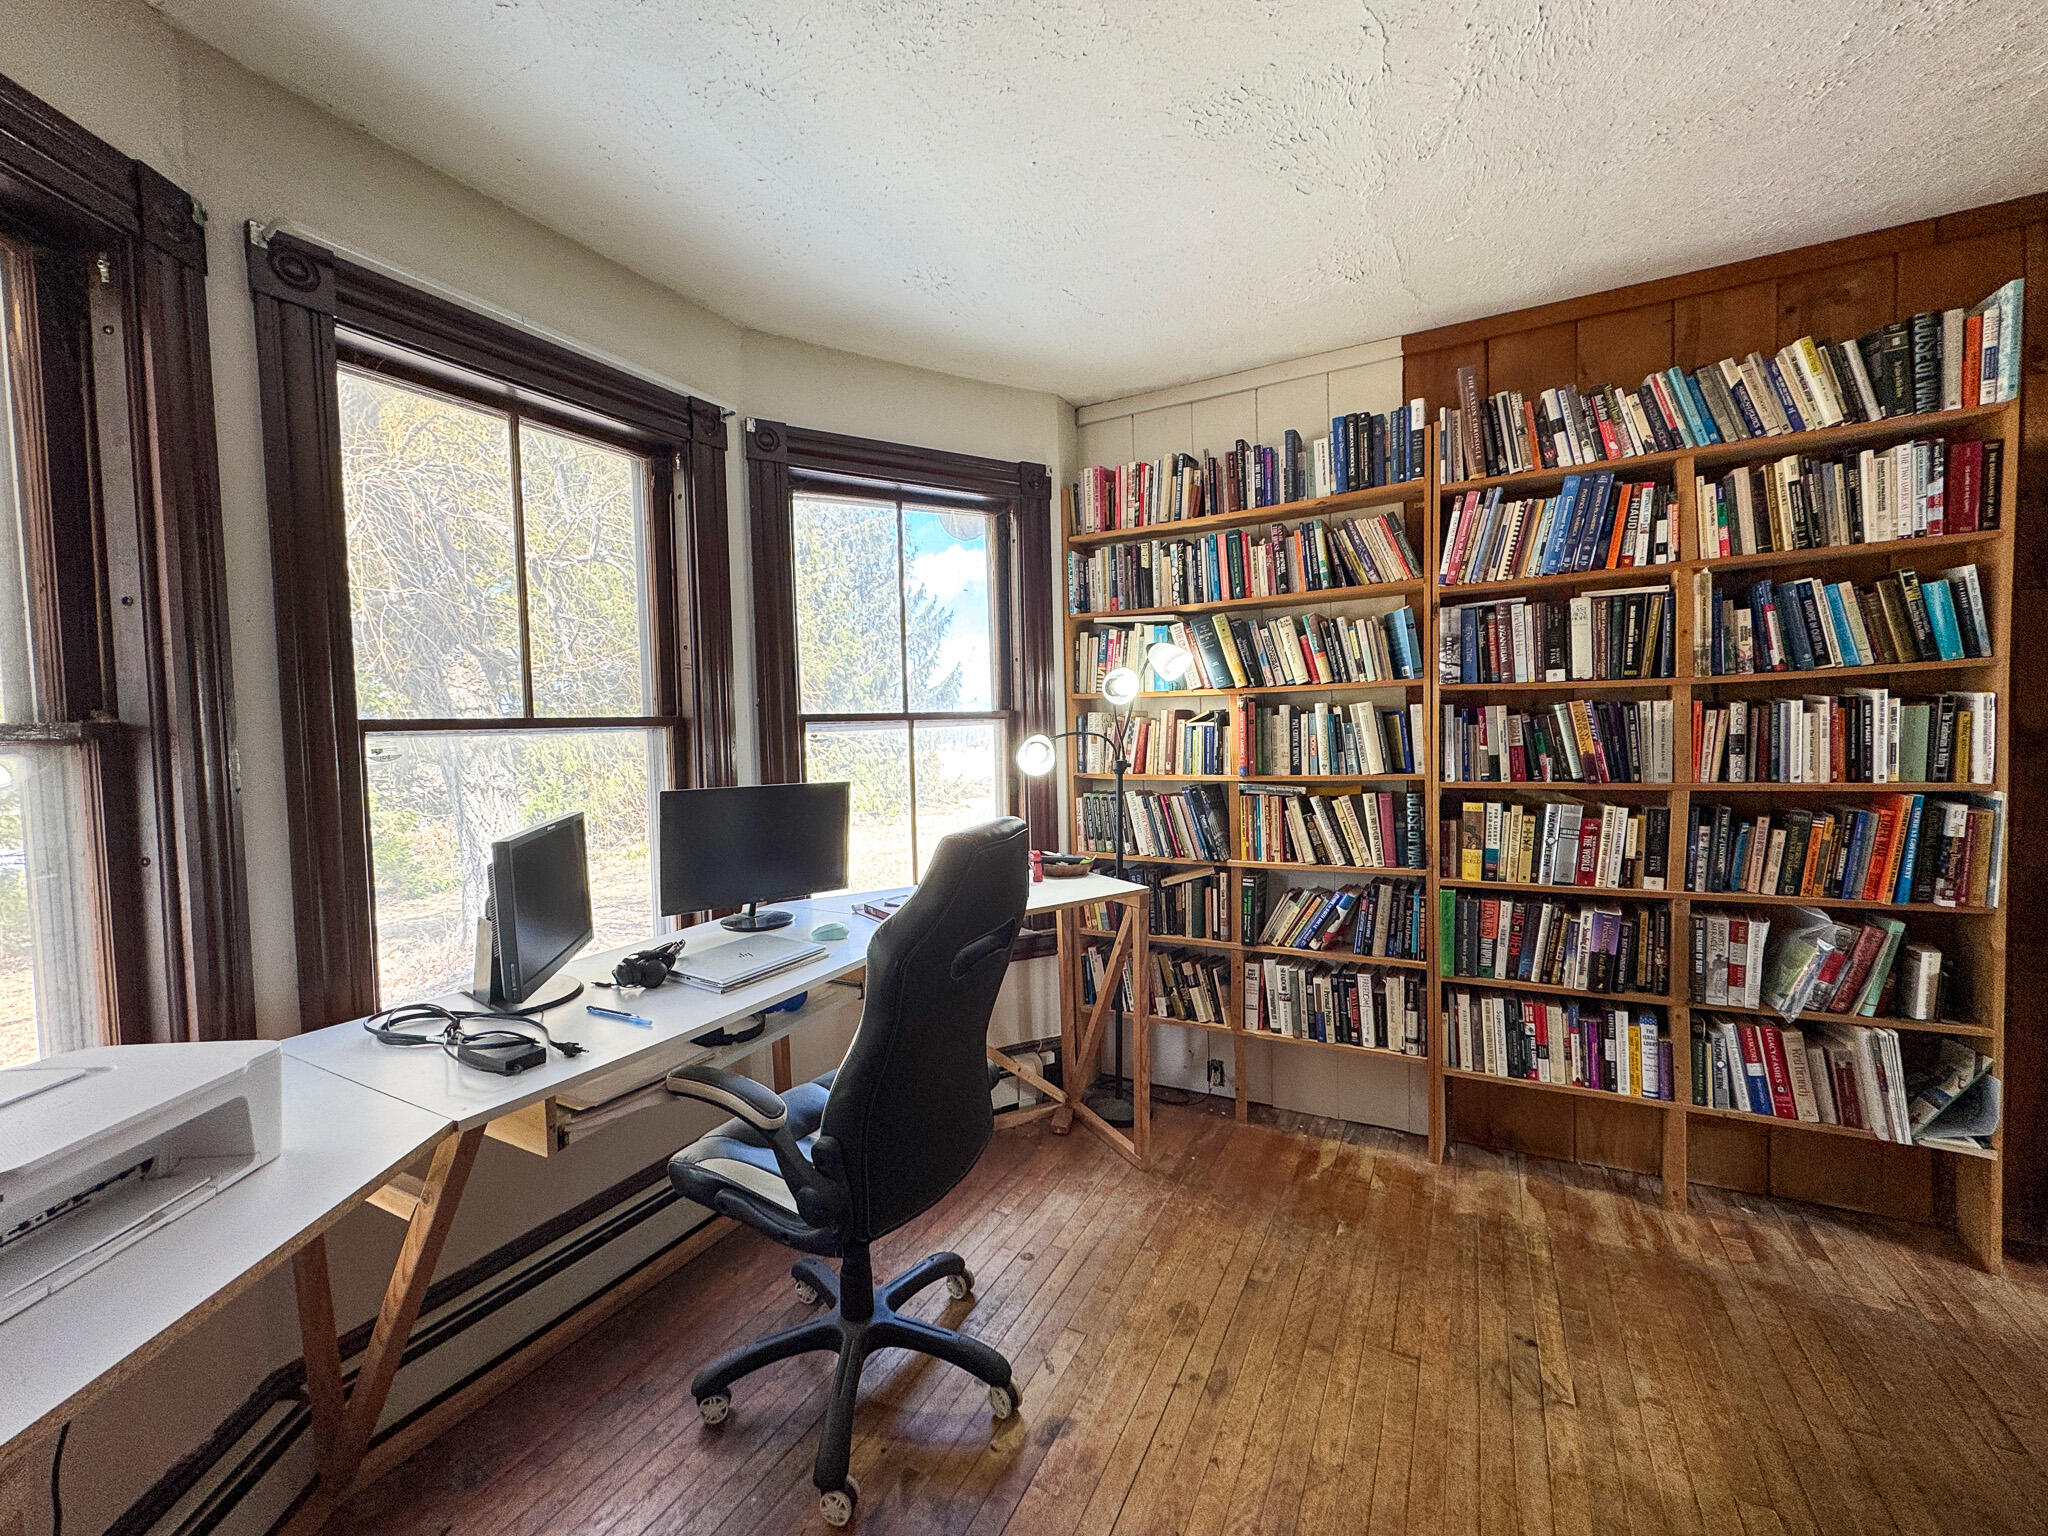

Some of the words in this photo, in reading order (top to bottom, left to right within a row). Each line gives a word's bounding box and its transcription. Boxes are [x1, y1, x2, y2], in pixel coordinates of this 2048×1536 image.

[1914, 314, 1936, 361] HOUSE
[1468, 392, 1476, 416] SAXON
[1914, 380, 1936, 414] WAR
[1511, 394, 1521, 426] HAPPENED
[1747, 409, 1759, 428] POLITICS
[1471, 418, 1481, 459] CHRONICLE
[1566, 420, 1574, 435] COUCH
[1900, 453, 1910, 464] THE
[1900, 466, 1910, 480] TWO
[1578, 488, 1587, 509] POLITICS
[1594, 485, 1604, 507] POLITICS
[1900, 482, 1910, 509] AMERICAS
[1560, 495, 1572, 524] Government
[1626, 497, 1641, 530] FRAUD
[1460, 509, 1473, 536] Government
[1571, 515, 1580, 536] AMERICA
[1588, 513, 1597, 534] AMERICA
[1177, 543, 1184, 552] No
[1554, 537, 1563, 553] People
[1453, 549, 1462, 564] People
[1513, 611, 1521, 621] The
[1803, 599, 1816, 622] EUROPE
[1808, 622, 1818, 630] IN
[1809, 629, 1820, 642] OUR
[1499, 626, 1507, 662] BYZANTIUM
[1515, 640, 1524, 656] Hand
[1812, 642, 1823, 656] TIME
[1584, 702, 1593, 718] TAKE
[1573, 710, 1587, 752] GOVERNMENT
[1588, 725, 1597, 740] BACK
[1406, 793, 1419, 830] HOUSE
[1605, 812, 1613, 828] MICHAEL
[1720, 813, 1728, 824] THE
[1899, 808, 1909, 835] AMERICAN
[1910, 806, 1921, 838] AMERICAN
[1545, 811, 1556, 838] NAOMI
[1719, 827, 1727, 837] AGE
[1878, 813, 1894, 838] CYBER
[1582, 835, 1592, 848] THE
[1875, 838, 1890, 858] WAR
[1408, 846, 1421, 869] WAR
[1542, 844, 1552, 866] KLEIN
[1580, 848, 1591, 871] WORLD
[1891, 835, 1903, 871] GOVERNMENT
[1903, 838, 1916, 879] GOVERNMENT
[1512, 912, 1525, 925] US
[1508, 931, 1522, 955] THEM
[1580, 927, 1590, 946] Standing
[1695, 929, 1704, 952] MERCHANT
[1710, 922, 1718, 952] MIRACLE
[1578, 950, 1588, 976] Armageddon
[1694, 960, 1702, 973] DEATH
[1279, 968, 1287, 990] SHADOW
[1361, 978, 1370, 1005] FREEDOM
[1765, 1027, 1776, 1054] LEGACY
[1771, 1060, 1782, 1083] ASHES
[1792, 1048, 1803, 1065] Red
